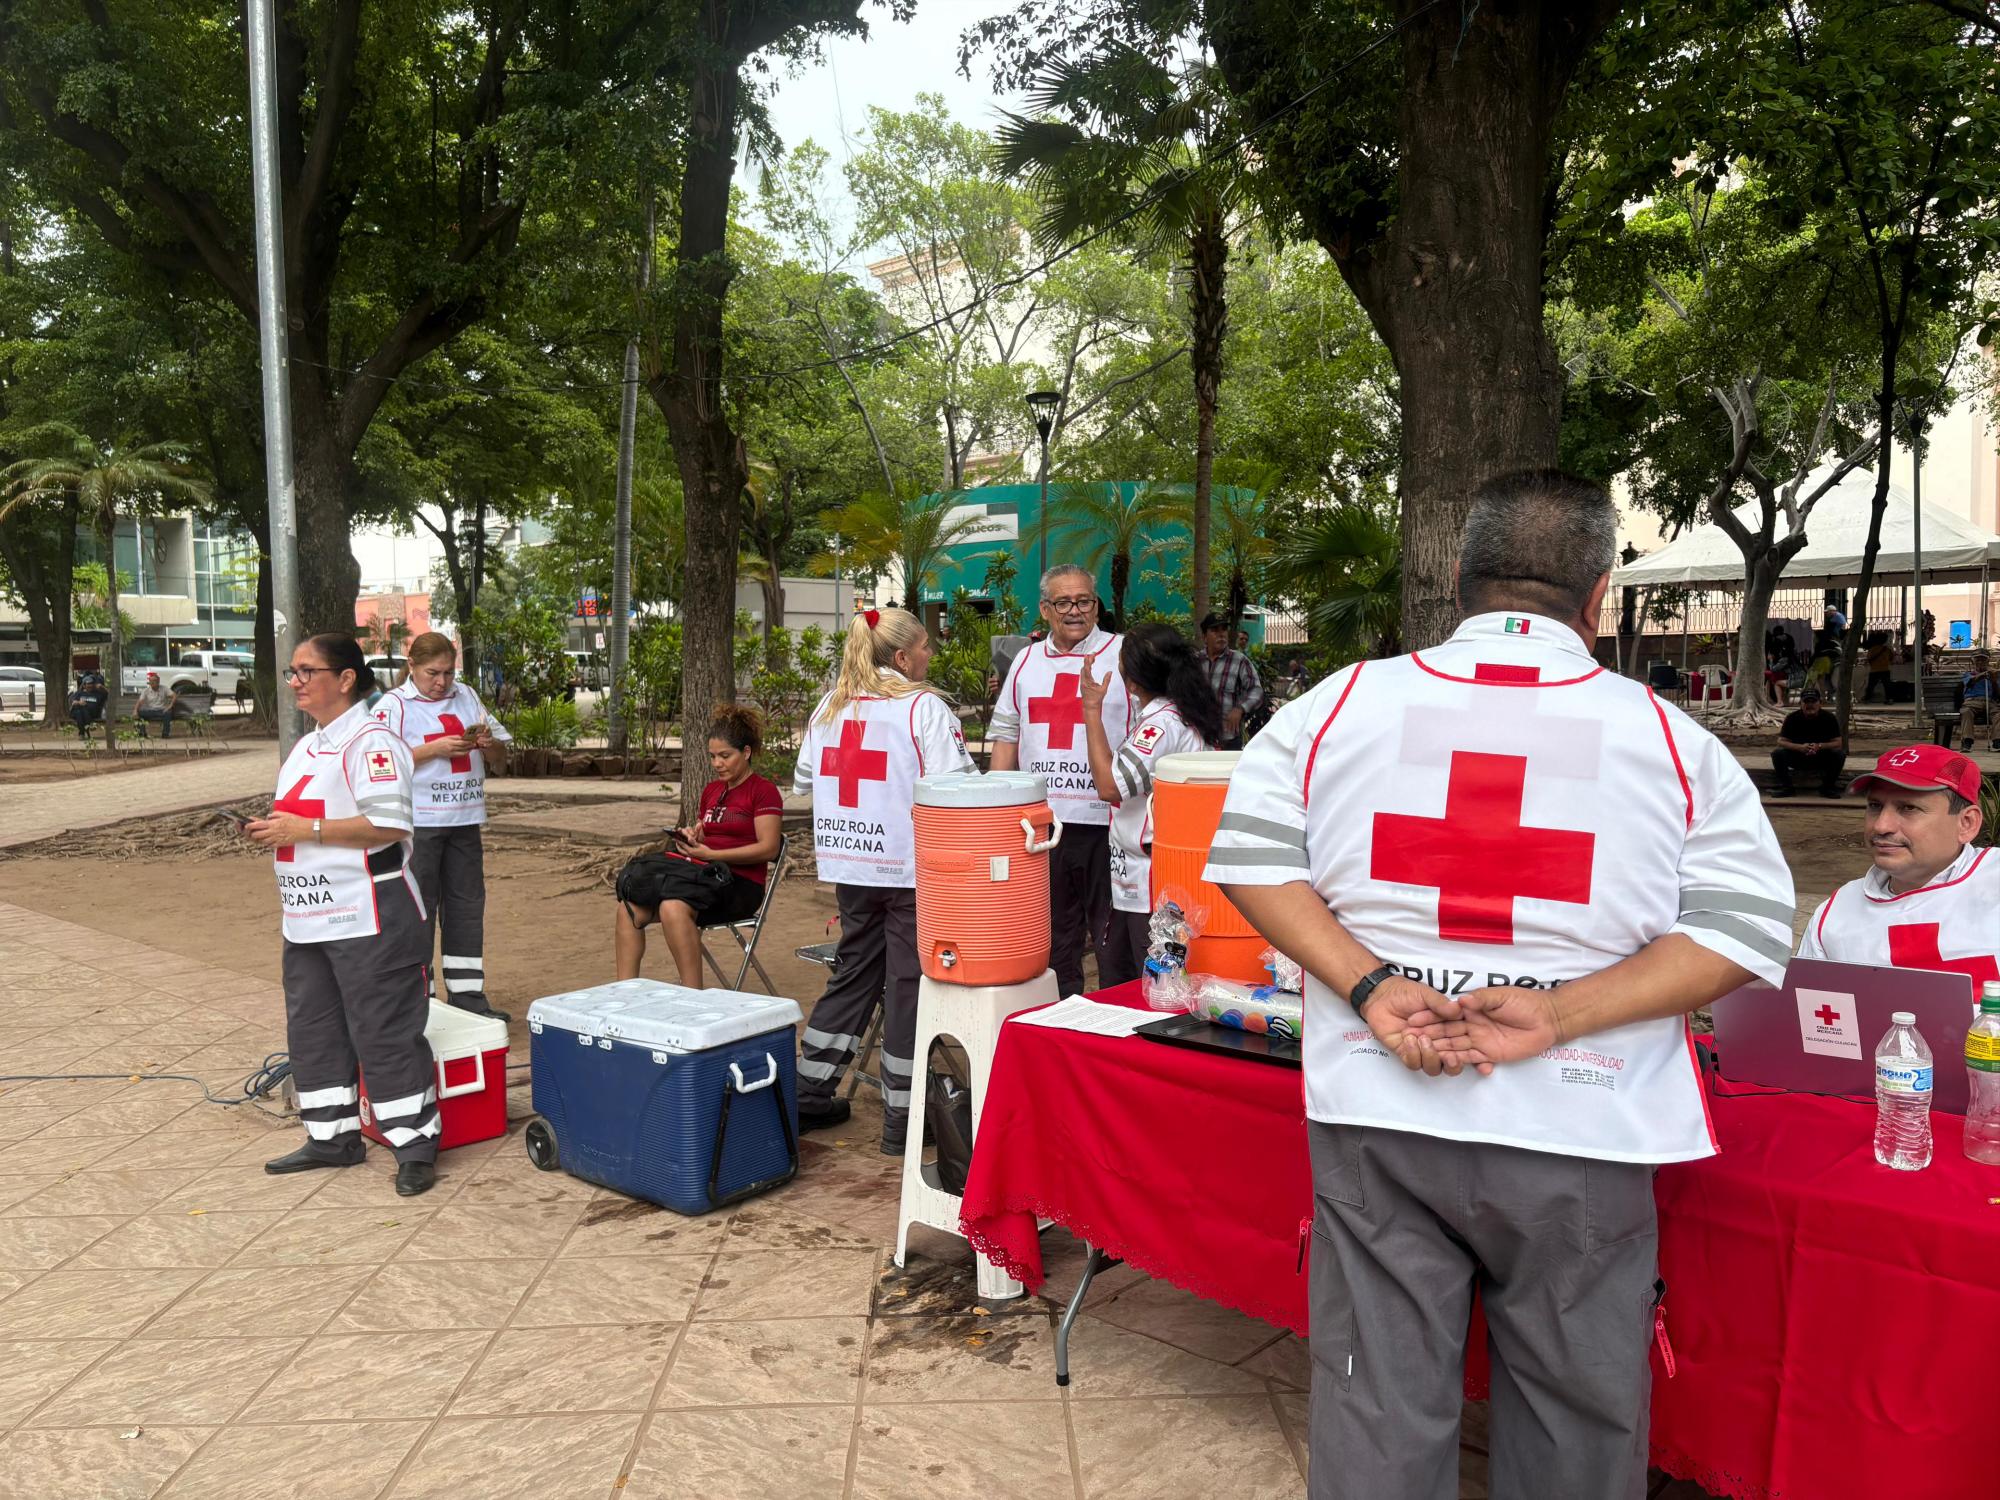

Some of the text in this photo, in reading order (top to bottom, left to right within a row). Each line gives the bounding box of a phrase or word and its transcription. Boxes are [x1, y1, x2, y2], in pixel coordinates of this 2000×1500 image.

[1031, 761, 1055, 773] CRUZ
[431, 781, 463, 791] CRUZ
[1046, 777, 1096, 790] ICANA
[432, 790, 485, 803] MEXICAN
[817, 818, 885, 836] CRUZ ROJA
[817, 835, 885, 853] MEXICANA
[287, 874, 331, 889] ROJA
